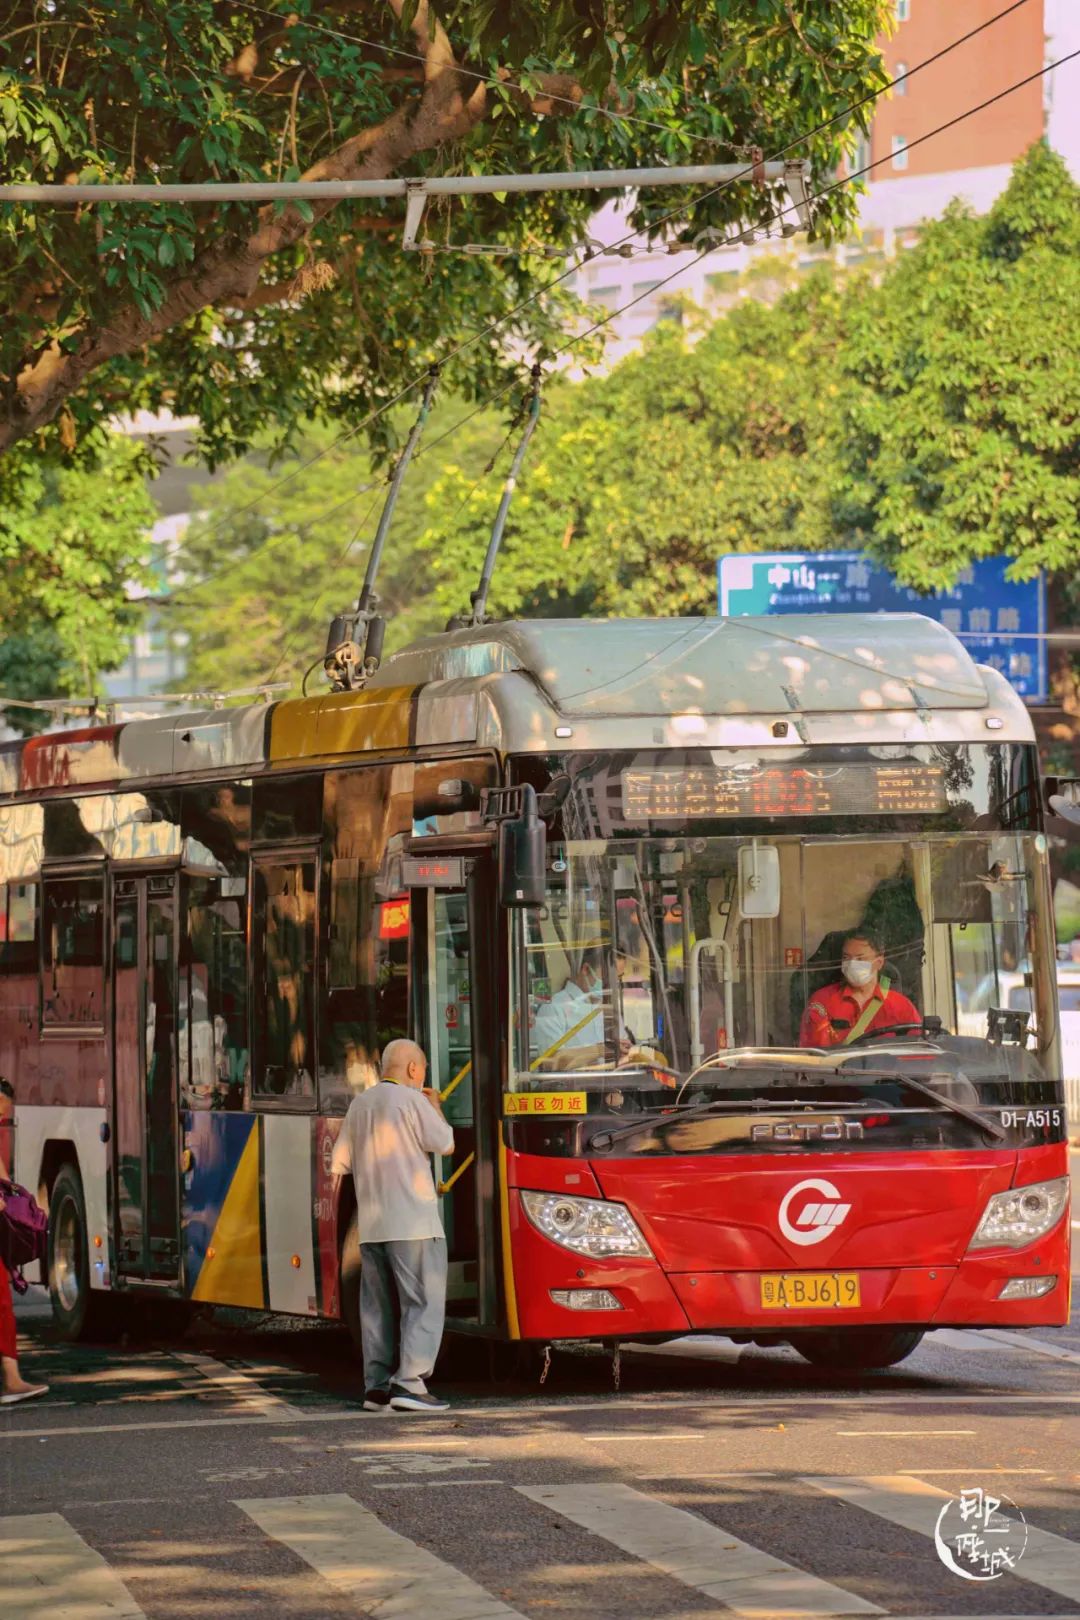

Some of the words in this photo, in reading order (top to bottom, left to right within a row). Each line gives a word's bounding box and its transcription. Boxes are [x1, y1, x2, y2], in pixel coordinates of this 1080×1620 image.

[519, 1097, 582, 1111] 盲区勿近
[1001, 1110, 1060, 1127] D1-A515
